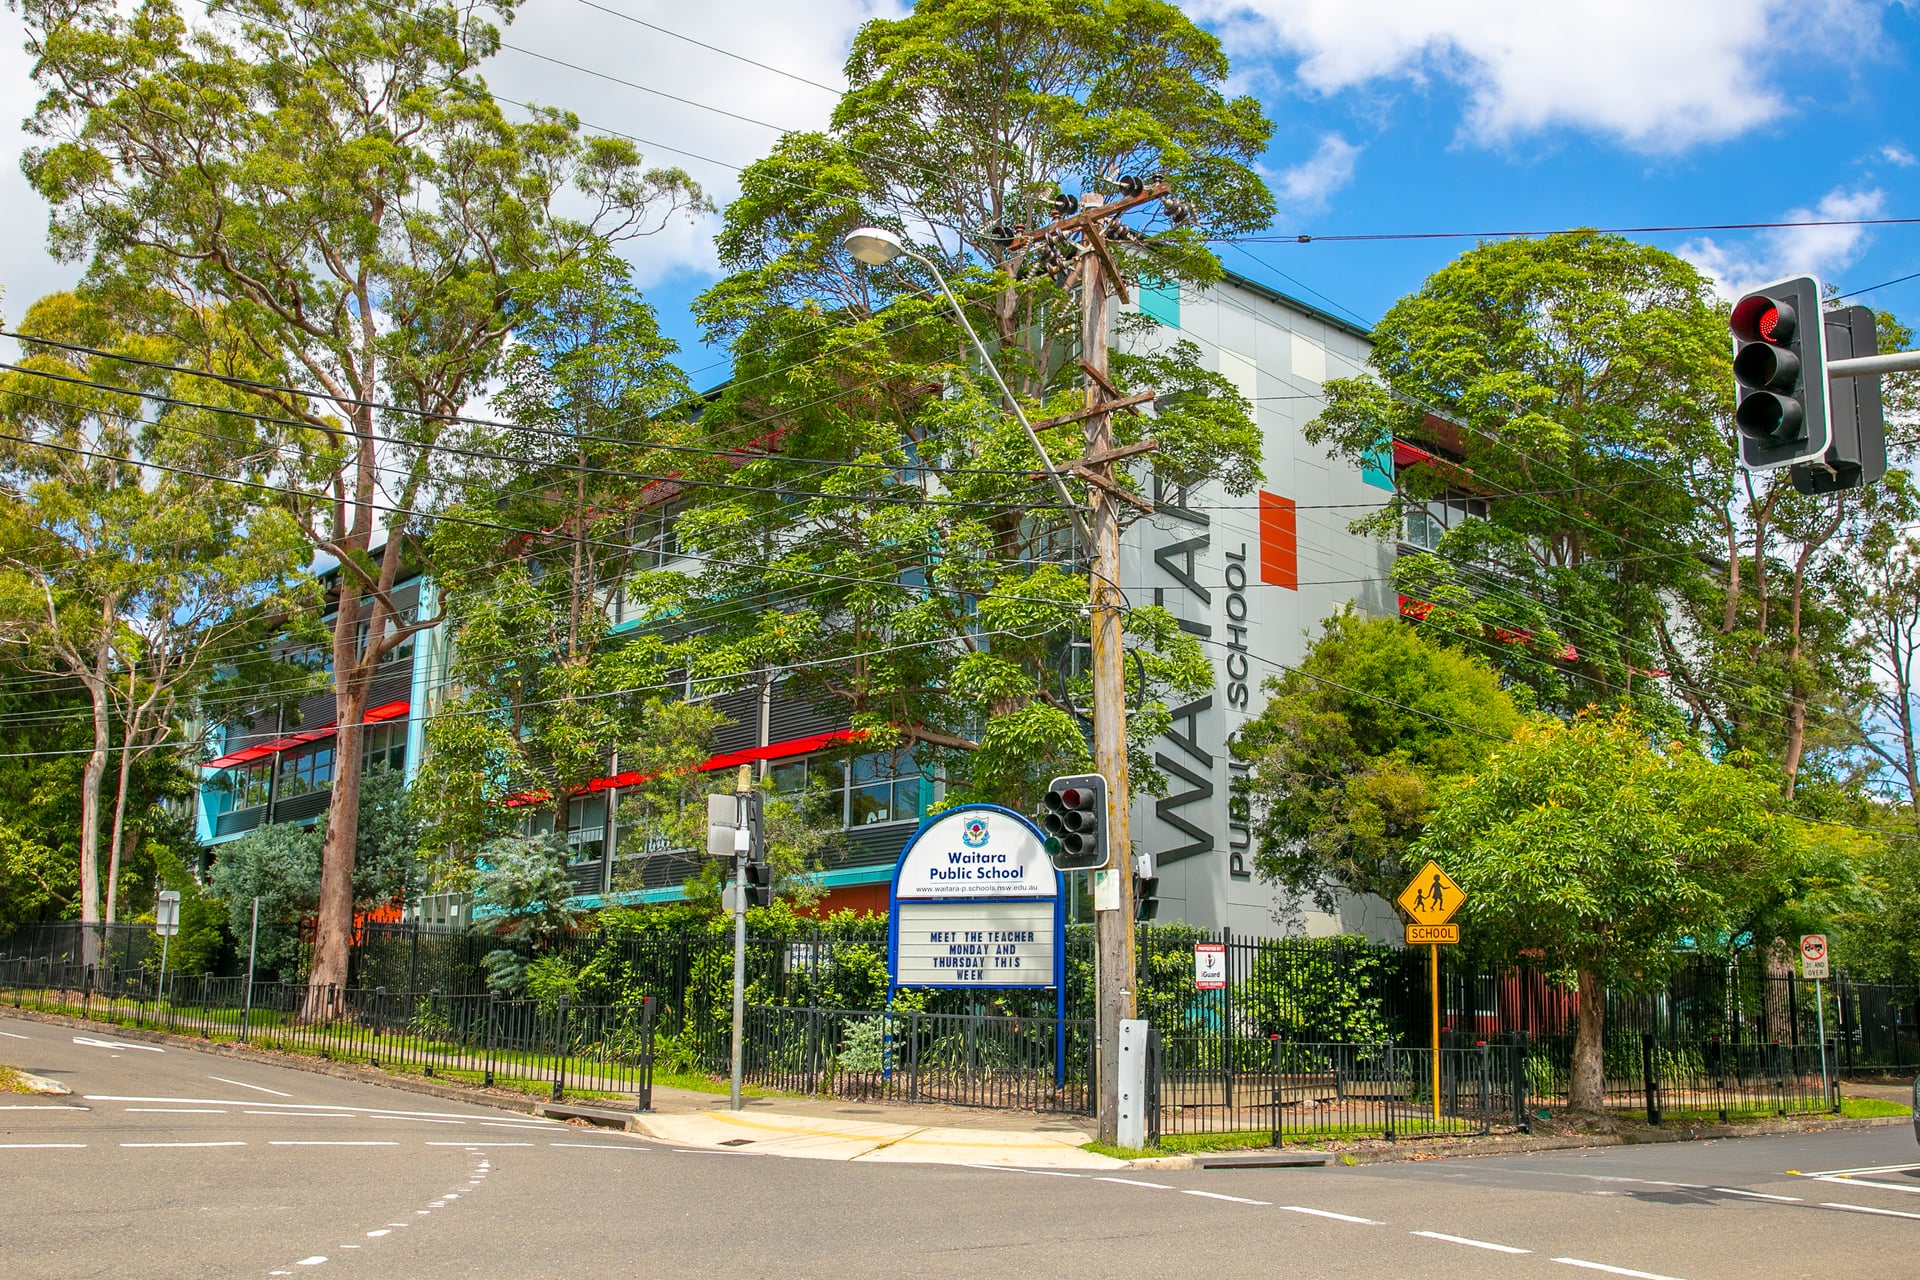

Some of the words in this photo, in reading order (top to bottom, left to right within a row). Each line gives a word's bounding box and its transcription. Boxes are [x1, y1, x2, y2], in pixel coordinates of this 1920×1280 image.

[1154, 385, 1214, 868] WATAR
[1225, 542, 1249, 708] SCHOOL
[948, 852, 1007, 864] Waitara
[930, 867, 972, 880] Public
[977, 865, 1024, 879] School
[916, 884, 1038, 893] www.waitara-p.schools.nsw.edu.au
[930, 931, 956, 943] MEET
[965, 931, 983, 942] THE
[988, 931, 1034, 942] TEACHER
[1411, 928, 1455, 939] SCHOOL
[949, 944, 989, 955] MONDAY
[996, 944, 1016, 955] AND
[933, 956, 985, 968] THURSDAY
[994, 956, 1020, 968] THIS
[957, 969, 983, 980] WEEK
